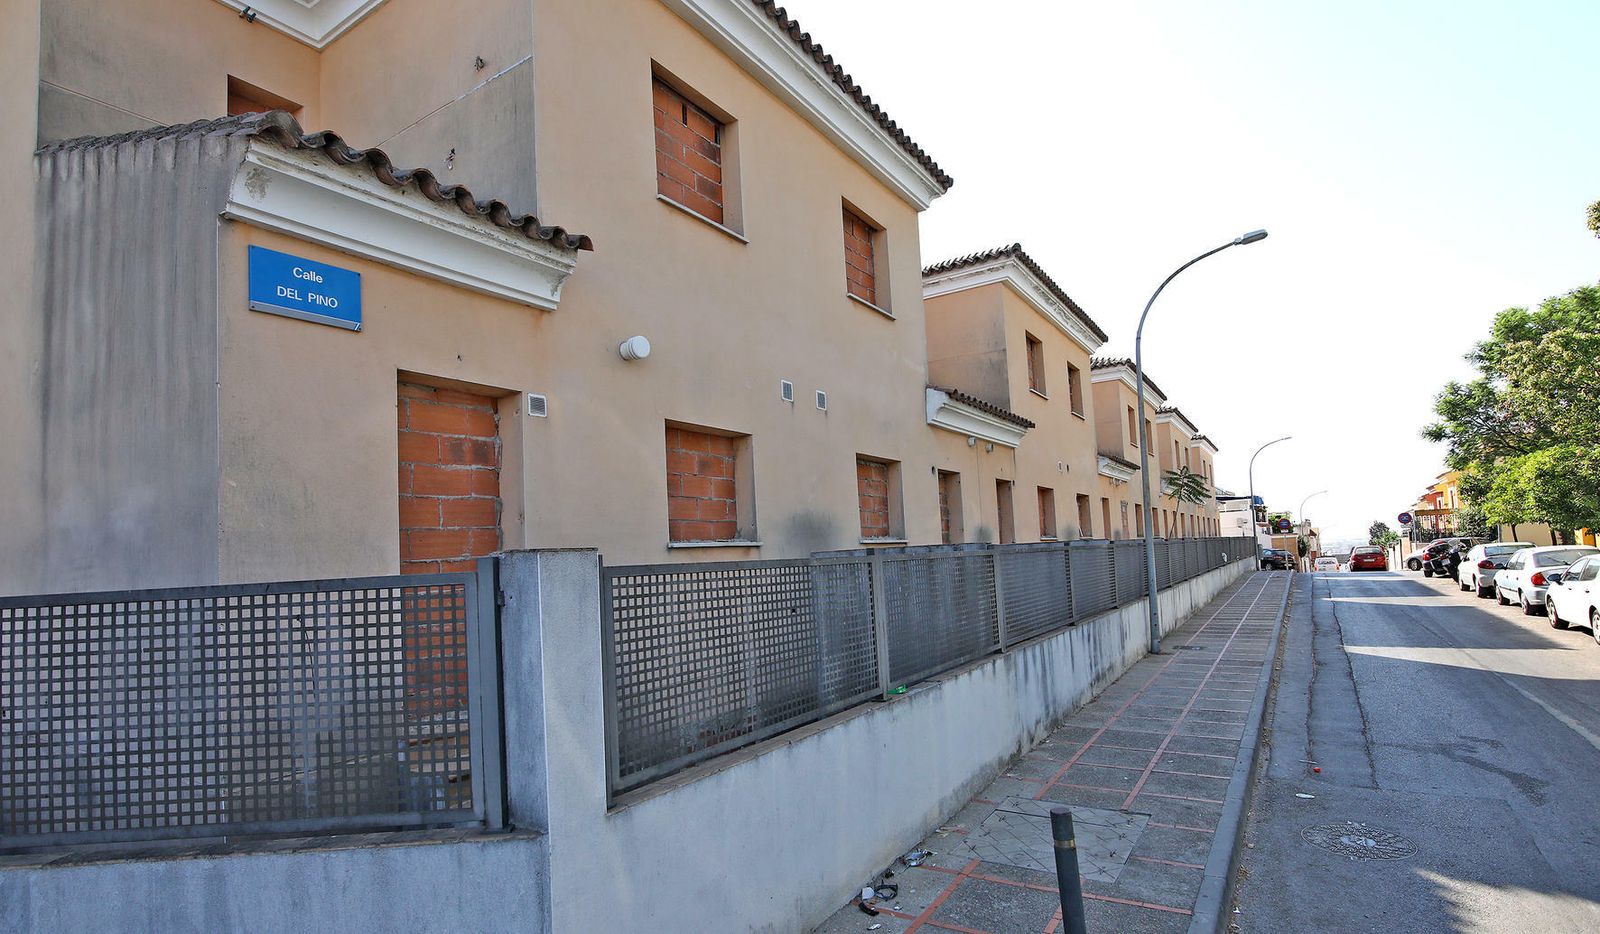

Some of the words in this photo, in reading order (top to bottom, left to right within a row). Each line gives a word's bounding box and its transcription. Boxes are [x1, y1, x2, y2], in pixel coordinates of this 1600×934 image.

[293, 267, 323, 283] Calle
[277, 285, 302, 301] DEL
[308, 293, 338, 308] PINO
